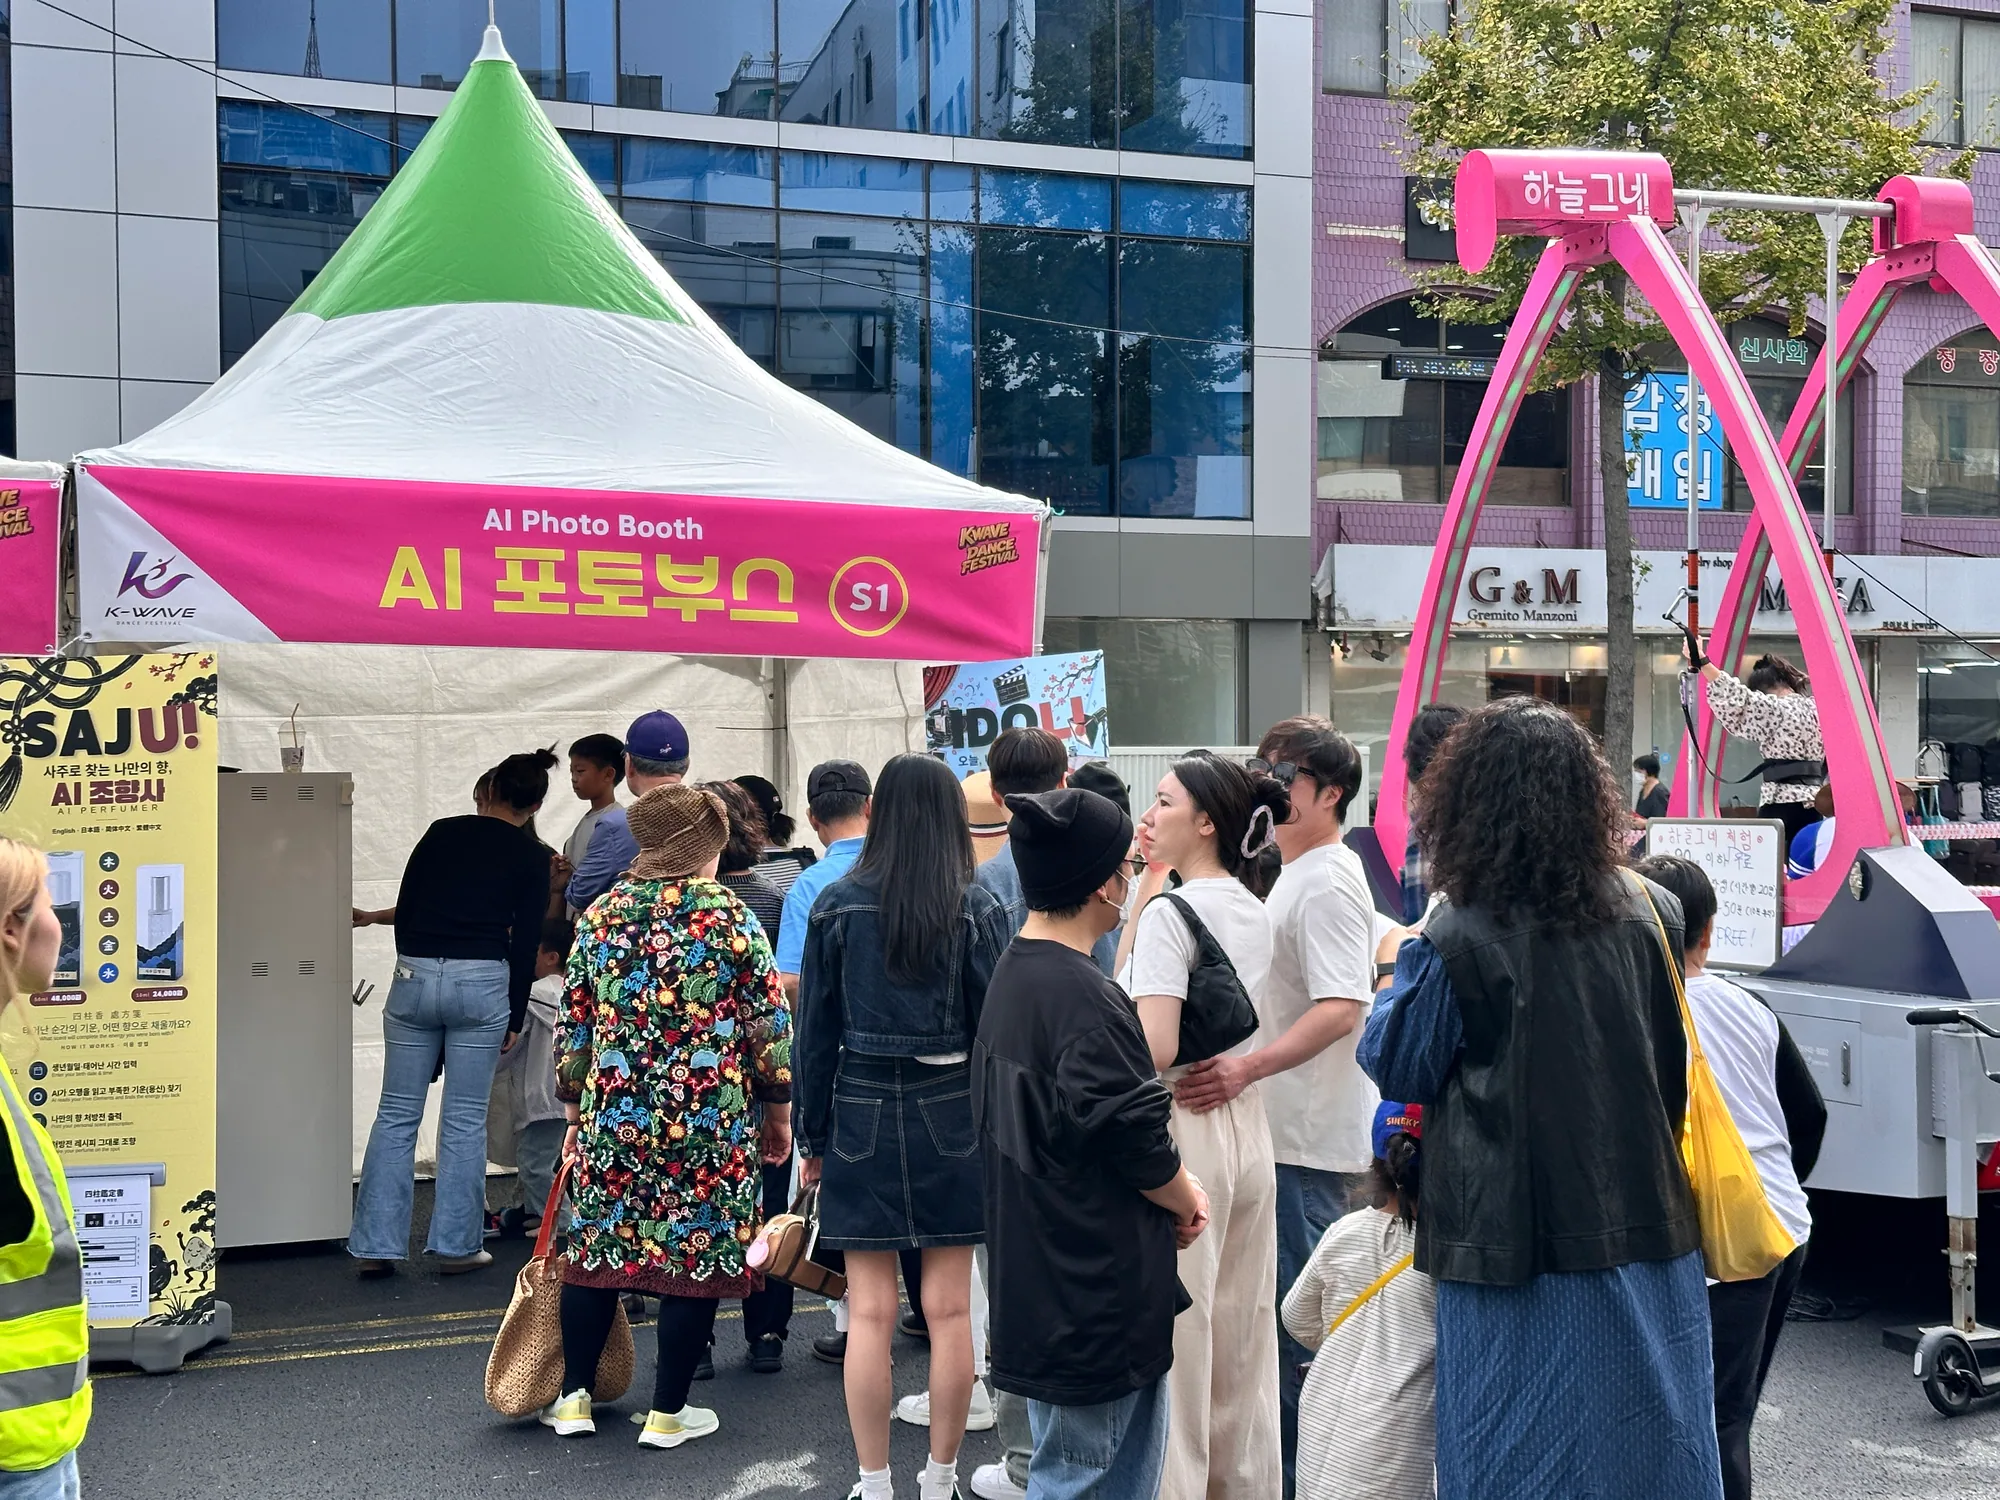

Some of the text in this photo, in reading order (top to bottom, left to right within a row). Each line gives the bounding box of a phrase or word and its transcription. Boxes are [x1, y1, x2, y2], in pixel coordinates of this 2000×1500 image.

[1522, 170, 1650, 215] 하늘그네
[1739, 337, 1808, 365] 신사화
[1624, 380, 1713, 435] 감정
[1626, 448, 1712, 501] 매입
[483, 508, 703, 540] AI Photo Booth
[967, 537, 1016, 560] DANCE
[961, 549, 1019, 576] FESTIVAL
[1680, 556, 1733, 570] jelry shop
[378, 546, 799, 624] AI 포토부스
[1468, 566, 1581, 605] G & M
[849, 582, 889, 612] S1
[105, 607, 197, 618] K-WAVE
[1467, 609, 1577, 622] Gremito Manzoni
[23, 703, 199, 758] SAJU!
[958, 755, 982, 767] 오늘,
[43, 760, 173, 779] 사주로 찾는 나만의 향,
[51, 779, 166, 806] AI 조향사
[57, 804, 159, 815] AI PERFUMER
[52, 827, 76, 835] English
[81, 826, 100, 834] 日本語
[102, 856, 116, 868] 木
[102, 884, 116, 896] 火
[102, 912, 116, 923] 土
[102, 940, 116, 951] 金
[102, 968, 116, 979] 水
[52, 1024, 77, 1034] 순간의
[80, 1023, 100, 1033] 기운,
[102, 1022, 120, 1032] 어떤
[122, 1021, 148, 1031] 향으로
[151, 1019, 191, 1030] 채울까요?
[106, 1061, 121, 1070] 시간
[123, 1060, 137, 1069] 입력
[51, 1089, 67, 1097] AI가
[68, 1087, 91, 1096] 오행을
[92, 1086, 107, 1096] 읽고
[108, 1085, 130, 1095] 부족한
[167, 1083, 182, 1093] 찾기
[51, 1112, 122, 1123] 나만의 향 처방전 출력
[74, 1138, 96, 1148] 레시피
[98, 1137, 119, 1146] 그대로
[121, 1137, 136, 1146] 조향
